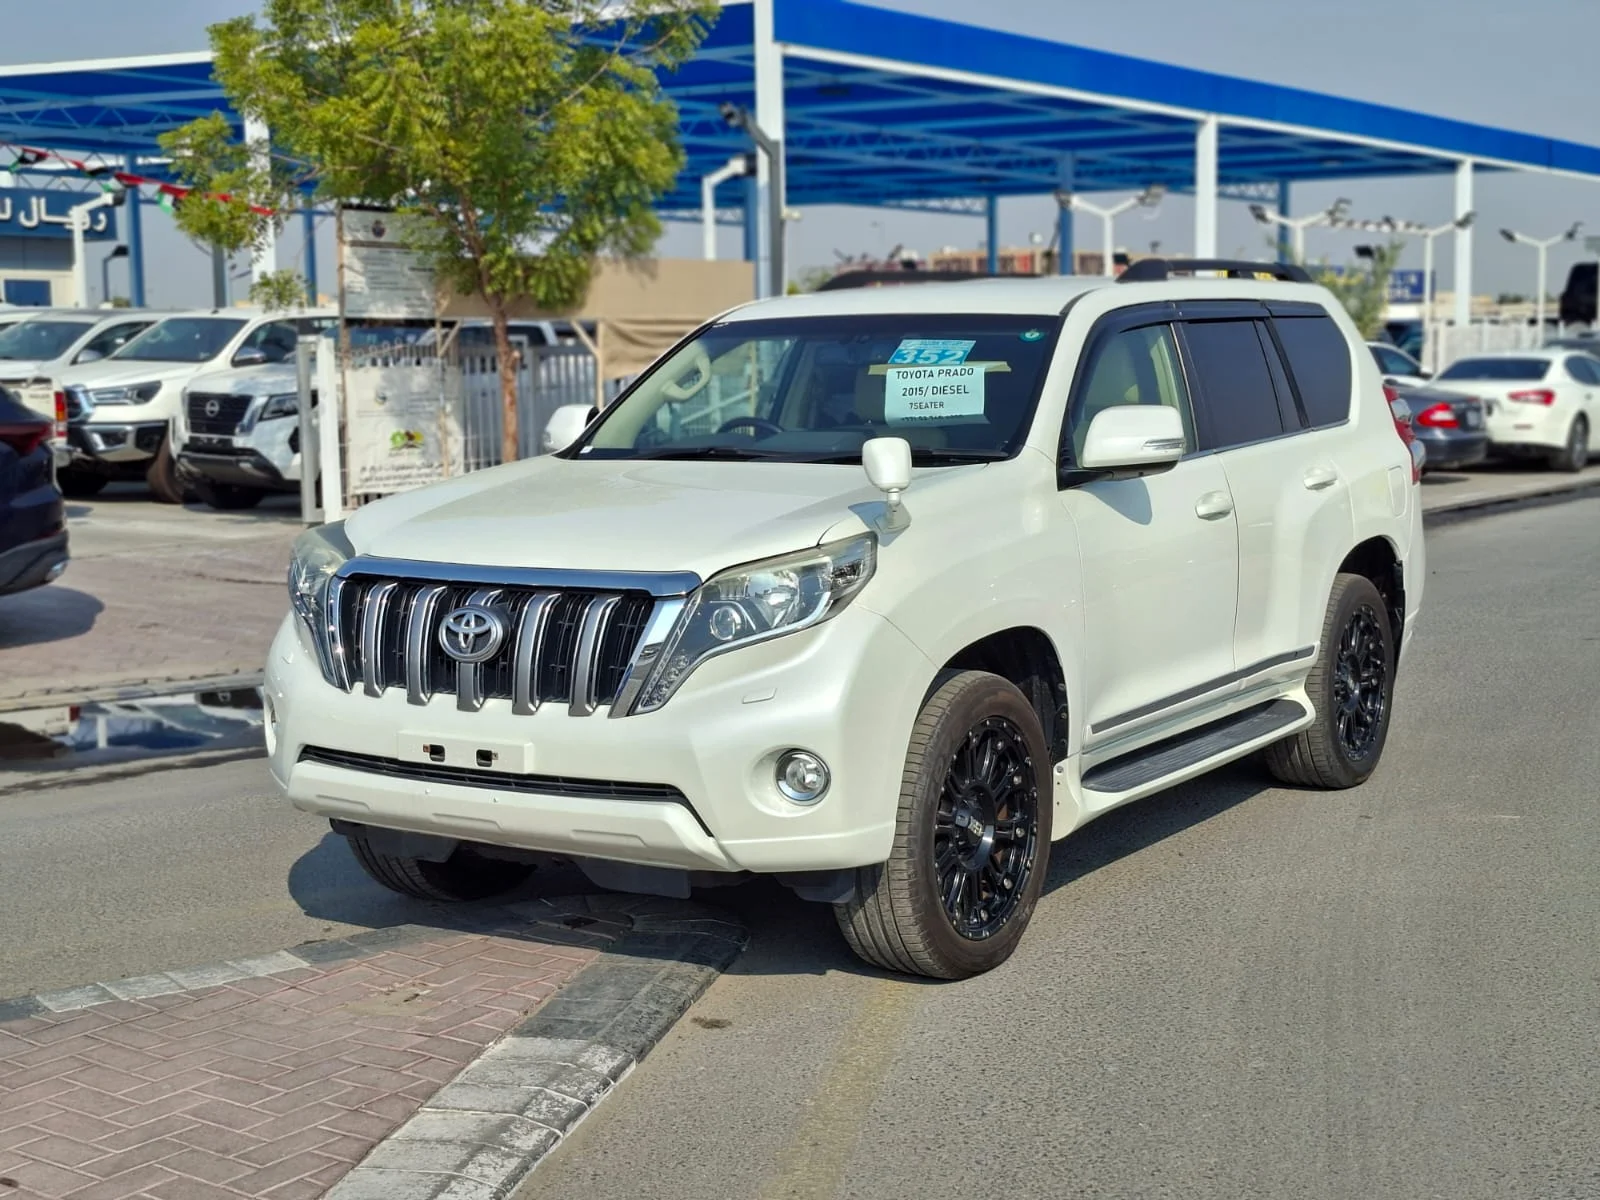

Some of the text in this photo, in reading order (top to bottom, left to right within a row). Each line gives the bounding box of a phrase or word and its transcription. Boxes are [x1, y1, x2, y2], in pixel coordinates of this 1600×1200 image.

[894, 349, 964, 364] 352
[896, 367, 974, 379] TOYOTA PRADO
[902, 385, 970, 397] 2015/ DIESEL
[909, 401, 945, 410] 7SEATER
